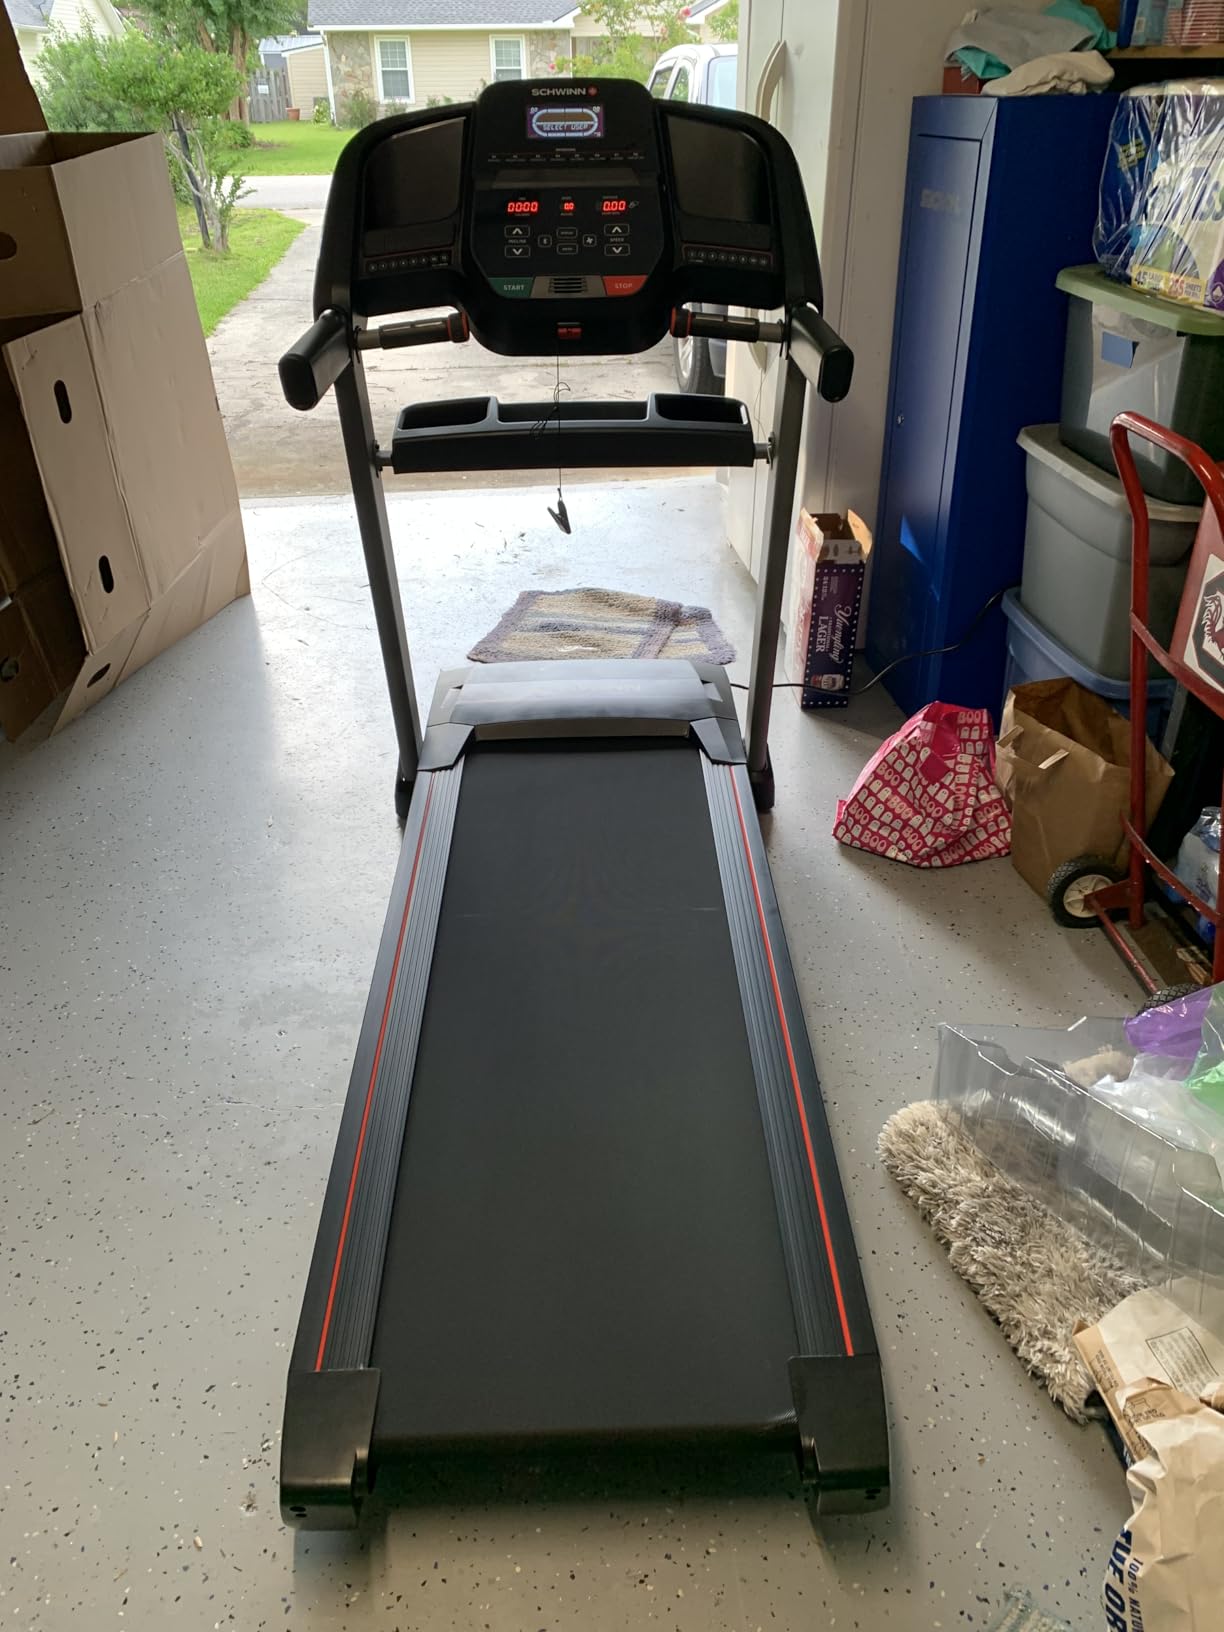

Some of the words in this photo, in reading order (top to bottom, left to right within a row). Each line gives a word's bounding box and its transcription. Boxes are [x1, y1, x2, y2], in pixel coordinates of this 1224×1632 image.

[531, 88, 587, 97] SCHWINN
[542, 123, 568, 131] SELECT
[816, 616, 829, 652] LAGER
[829, 604, 852, 664] Yuengling
[957, 711, 982, 724] BOO
[876, 761, 900, 786] BOO
[848, 801, 869, 825] BOO
[887, 795, 913, 820] BOO
[920, 793, 943, 818] BOO
[975, 802, 1001, 824] BOO
[861, 830, 887, 852] BOO
[902, 826, 923, 851] BOO
[1127, 1558, 1144, 1594] 100%
